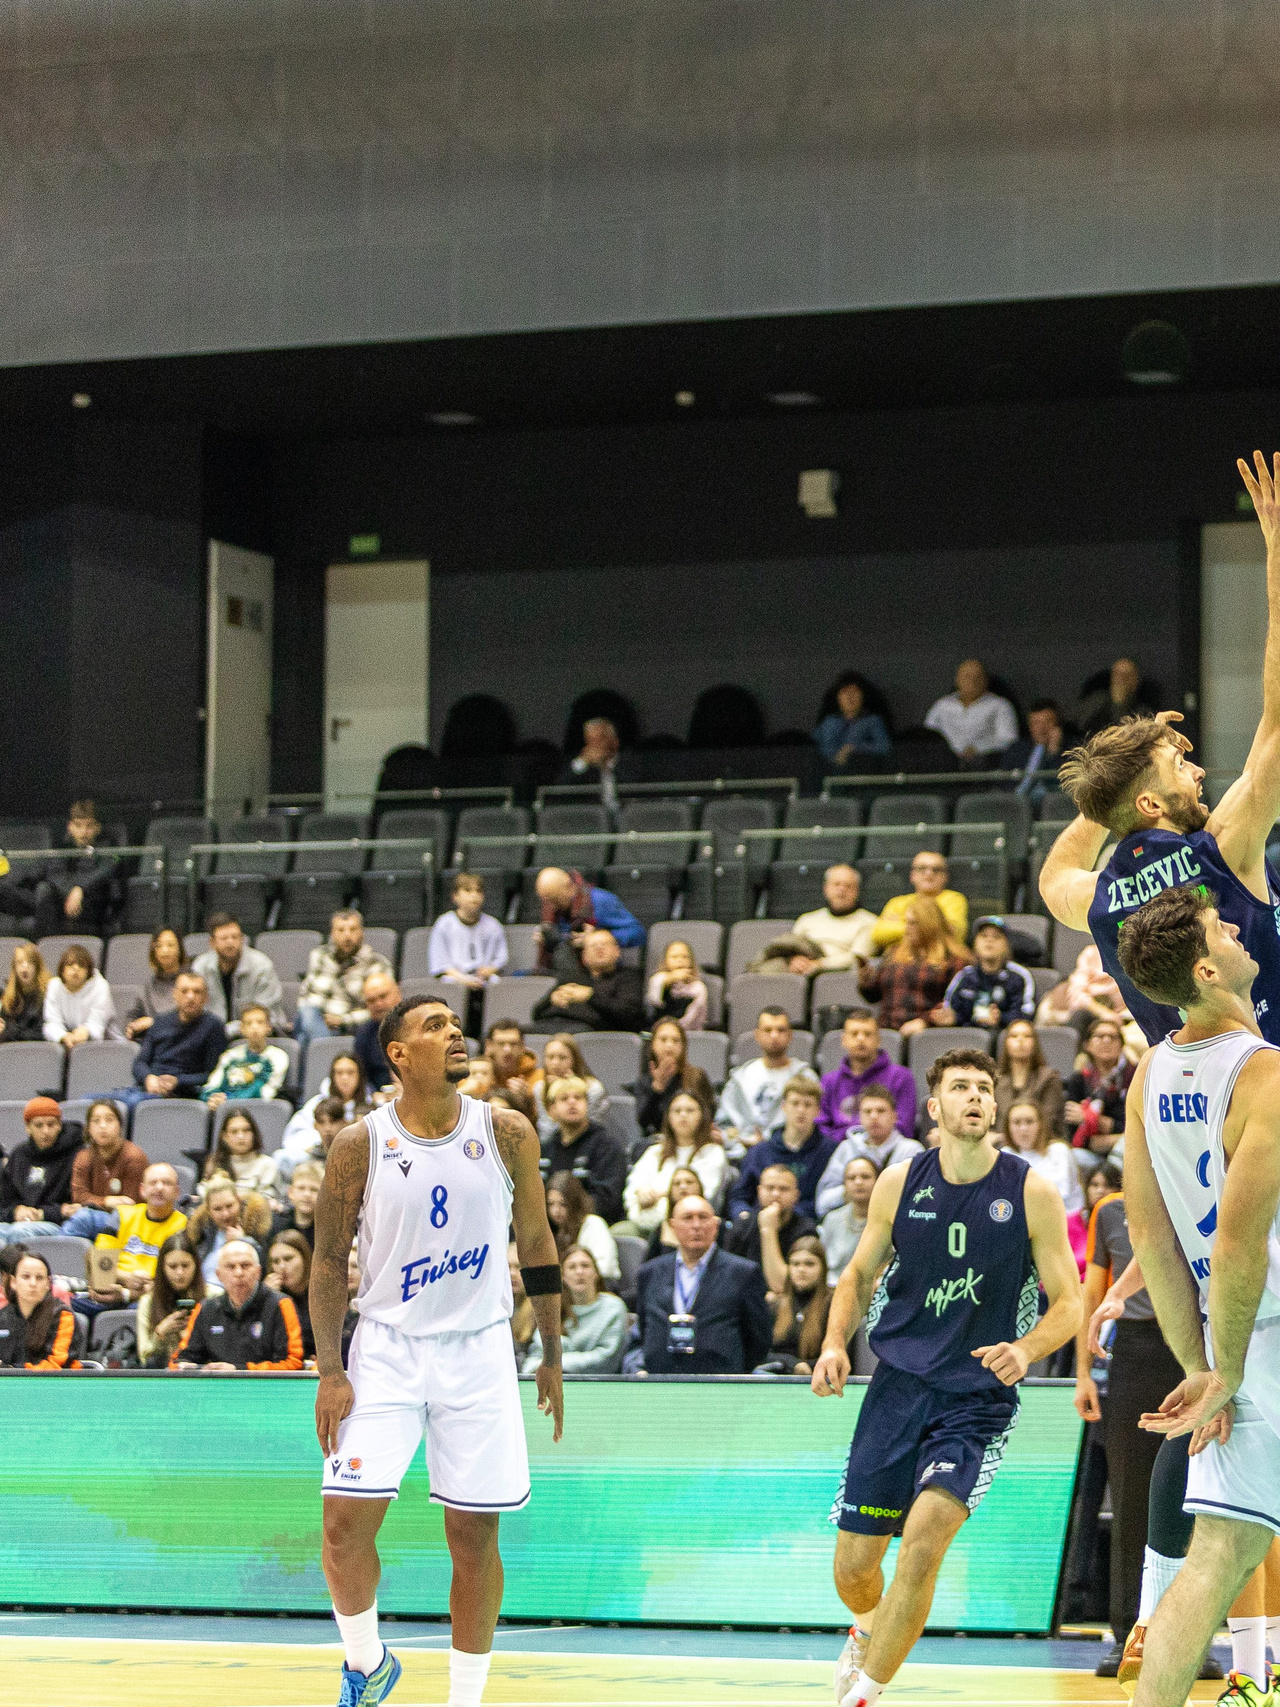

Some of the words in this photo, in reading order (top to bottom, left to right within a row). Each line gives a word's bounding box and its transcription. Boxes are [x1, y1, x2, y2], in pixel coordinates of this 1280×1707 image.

[1107, 845, 1201, 913] ZECEVIC
[429, 1184, 449, 1229] 8
[908, 1209, 937, 1221] Kempa
[948, 1221, 967, 1259] 0
[400, 1243, 490, 1303] Enisey
